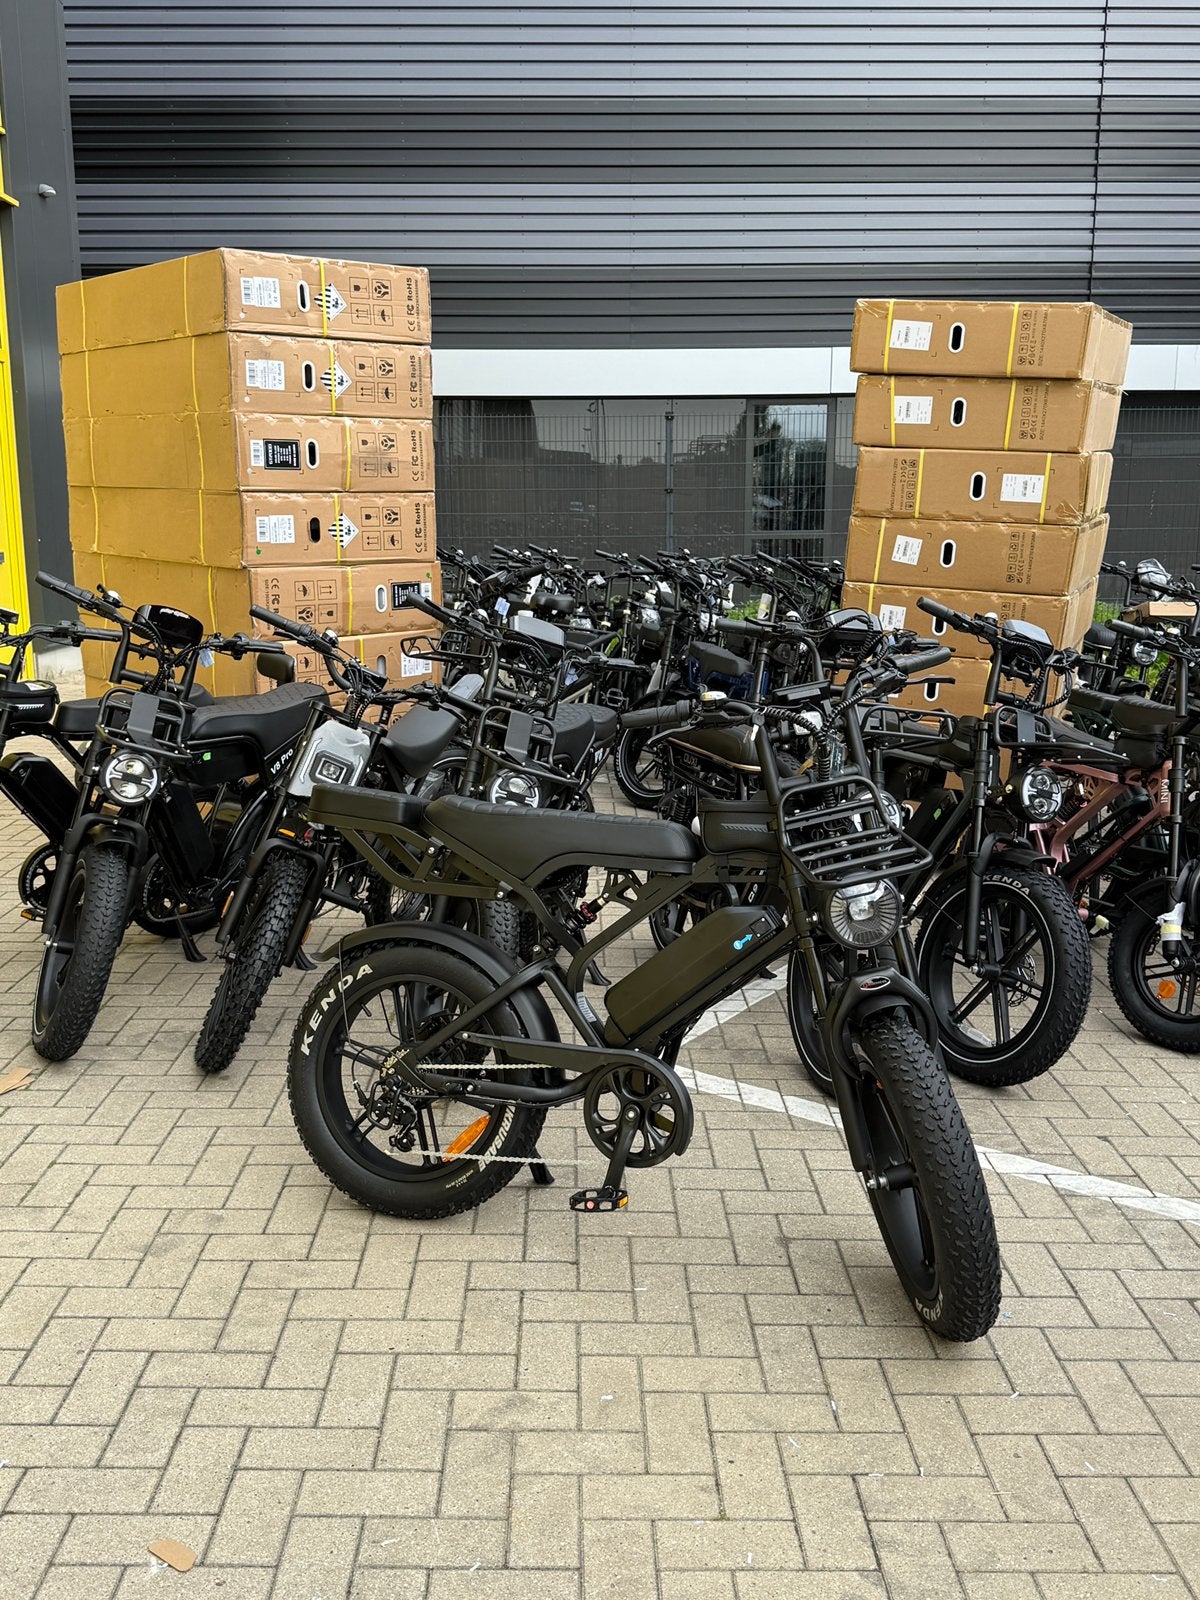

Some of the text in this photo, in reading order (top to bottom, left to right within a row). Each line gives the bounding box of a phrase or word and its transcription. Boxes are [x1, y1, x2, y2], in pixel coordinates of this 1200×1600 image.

[407, 320, 416, 332] CE
[410, 396, 418, 408] CE
[411, 470, 419, 481] CE
[415, 542, 423, 553] CE
[270, 578, 280, 590] CE
[270, 748, 294, 774] V8 Pro
[1160, 778, 1170, 803] MINI
[982, 874, 1030, 895] KENDA
[300, 964, 373, 1056] KENDA
